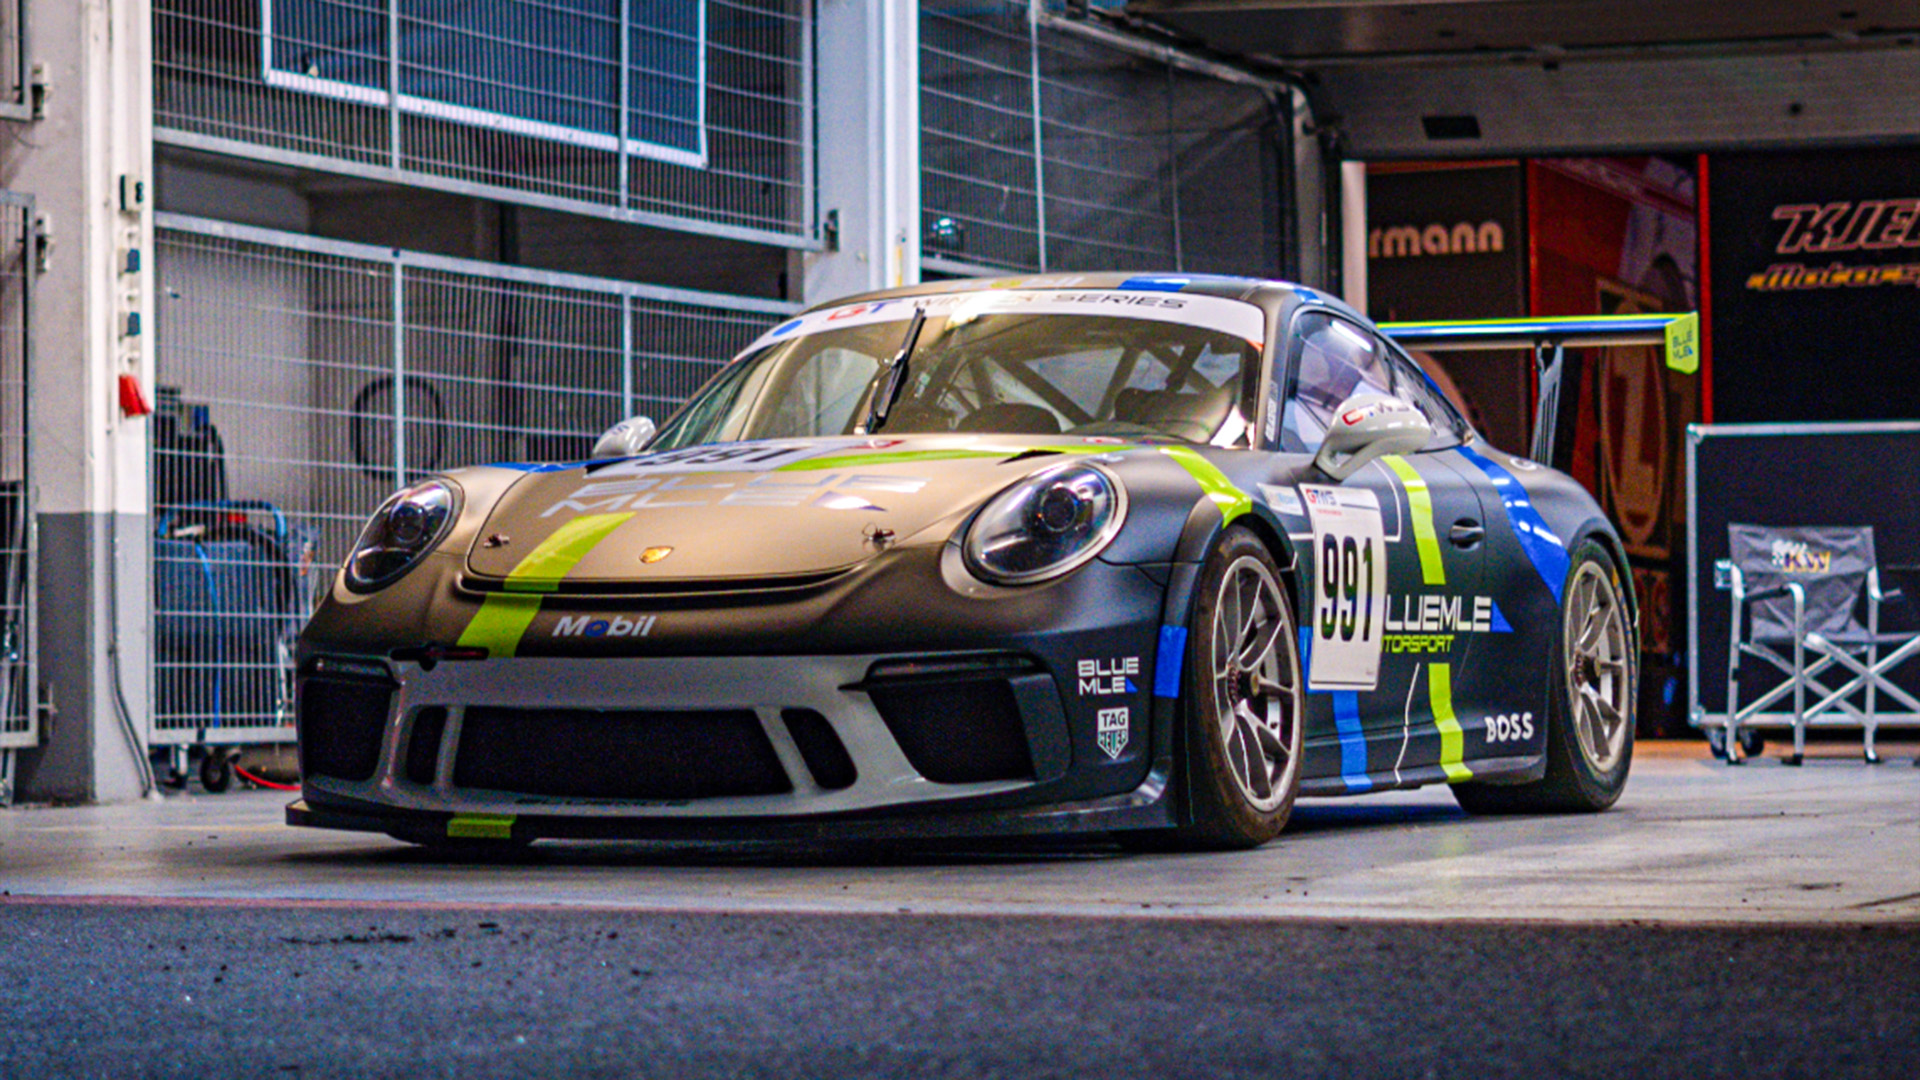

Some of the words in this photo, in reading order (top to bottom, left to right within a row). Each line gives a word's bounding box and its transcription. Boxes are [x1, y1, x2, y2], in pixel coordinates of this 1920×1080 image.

[1368, 221, 1503, 258] rmann
[1051, 293, 1188, 309] SERIES
[569, 474, 932, 499] BLUE
[1321, 533, 1373, 642] 991
[1385, 594, 1492, 633] LUEMLE
[551, 615, 657, 637] Mobil
[1380, 634, 1455, 654] TORSPORT
[1078, 656, 1139, 677] BLUE
[1079, 676, 1126, 696] MLE
[1101, 711, 1126, 728] TAG
[1484, 711, 1535, 743] BOSS
